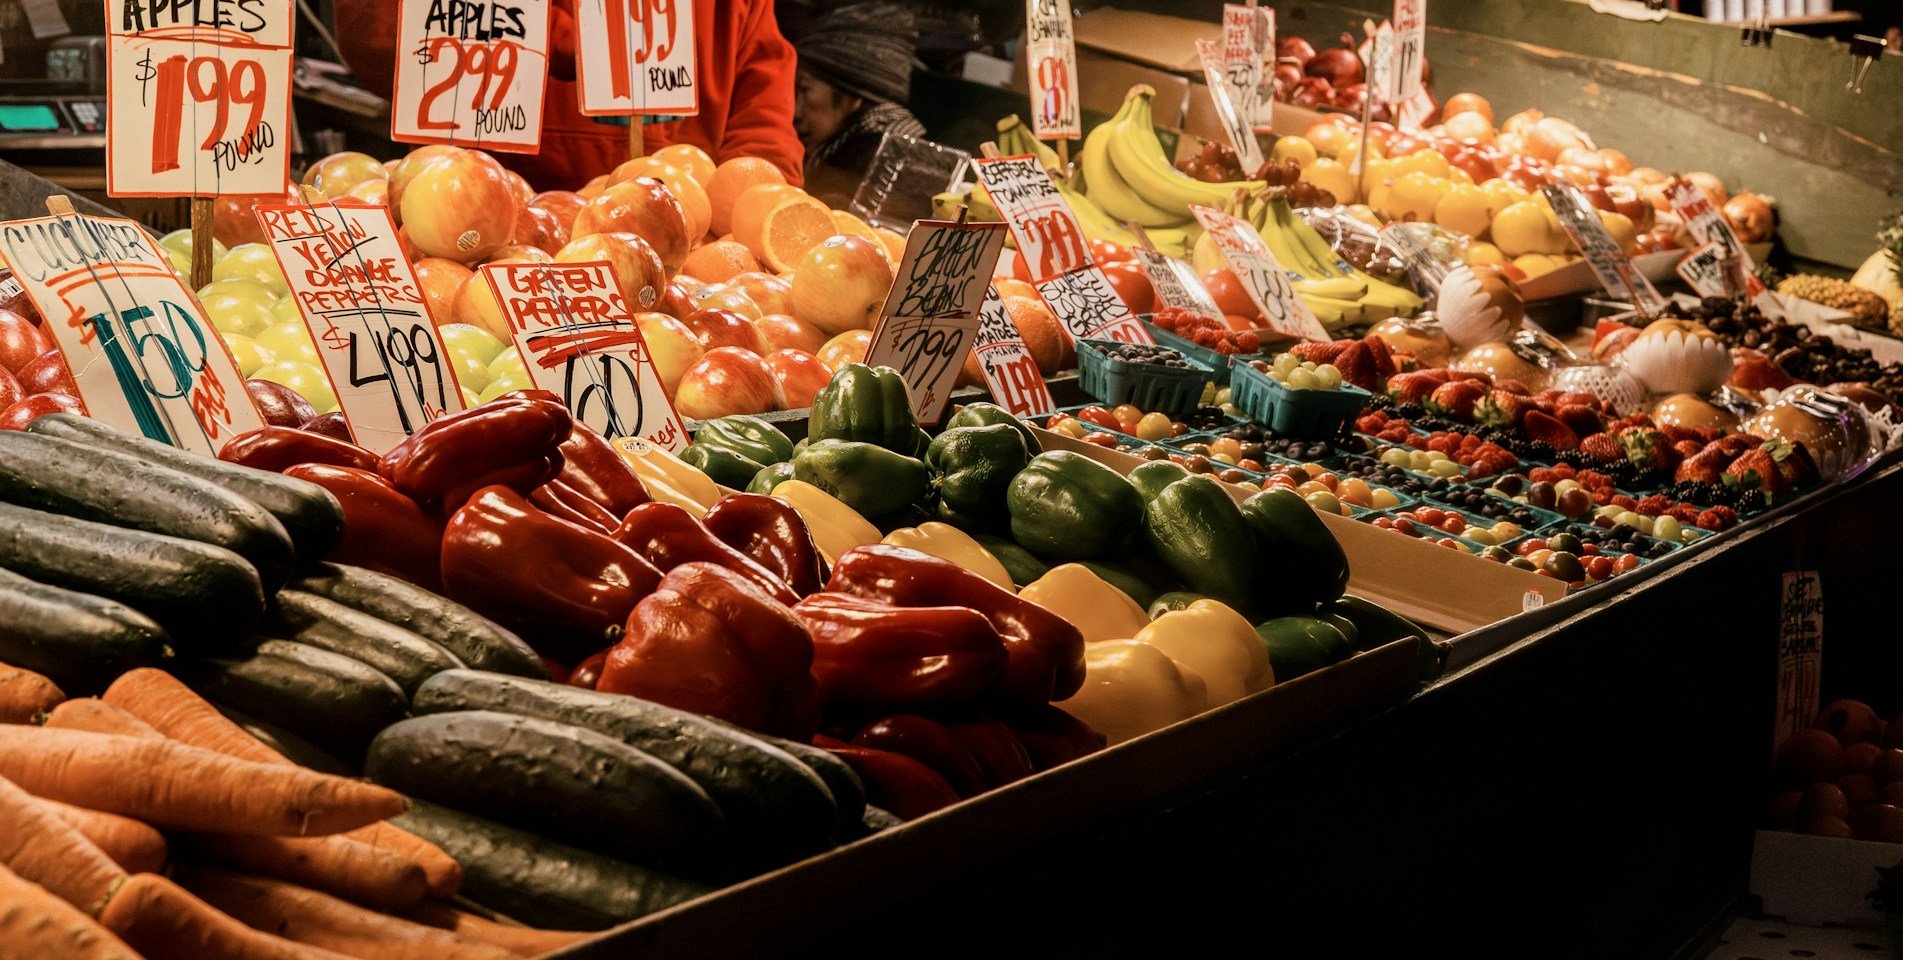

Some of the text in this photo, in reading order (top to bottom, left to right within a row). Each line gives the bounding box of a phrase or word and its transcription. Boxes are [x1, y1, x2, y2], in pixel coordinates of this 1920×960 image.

[123, 0, 267, 32] APPLES
[425, 0, 526, 41] APPLES
[650, 66, 692, 91] POUND
[474, 104, 527, 137] POUND
[213, 121, 274, 178] POUND
[262, 210, 334, 239] RED
[5, 216, 154, 281] CUCUMBER
[305, 258, 402, 287] ORANGE
[507, 267, 606, 296] GREEN
[300, 284, 424, 312] PEPPERS
[510, 293, 634, 329] PEPPERS
[895, 276, 975, 317] BEANS
[972, 323, 1021, 346] OMATOES
